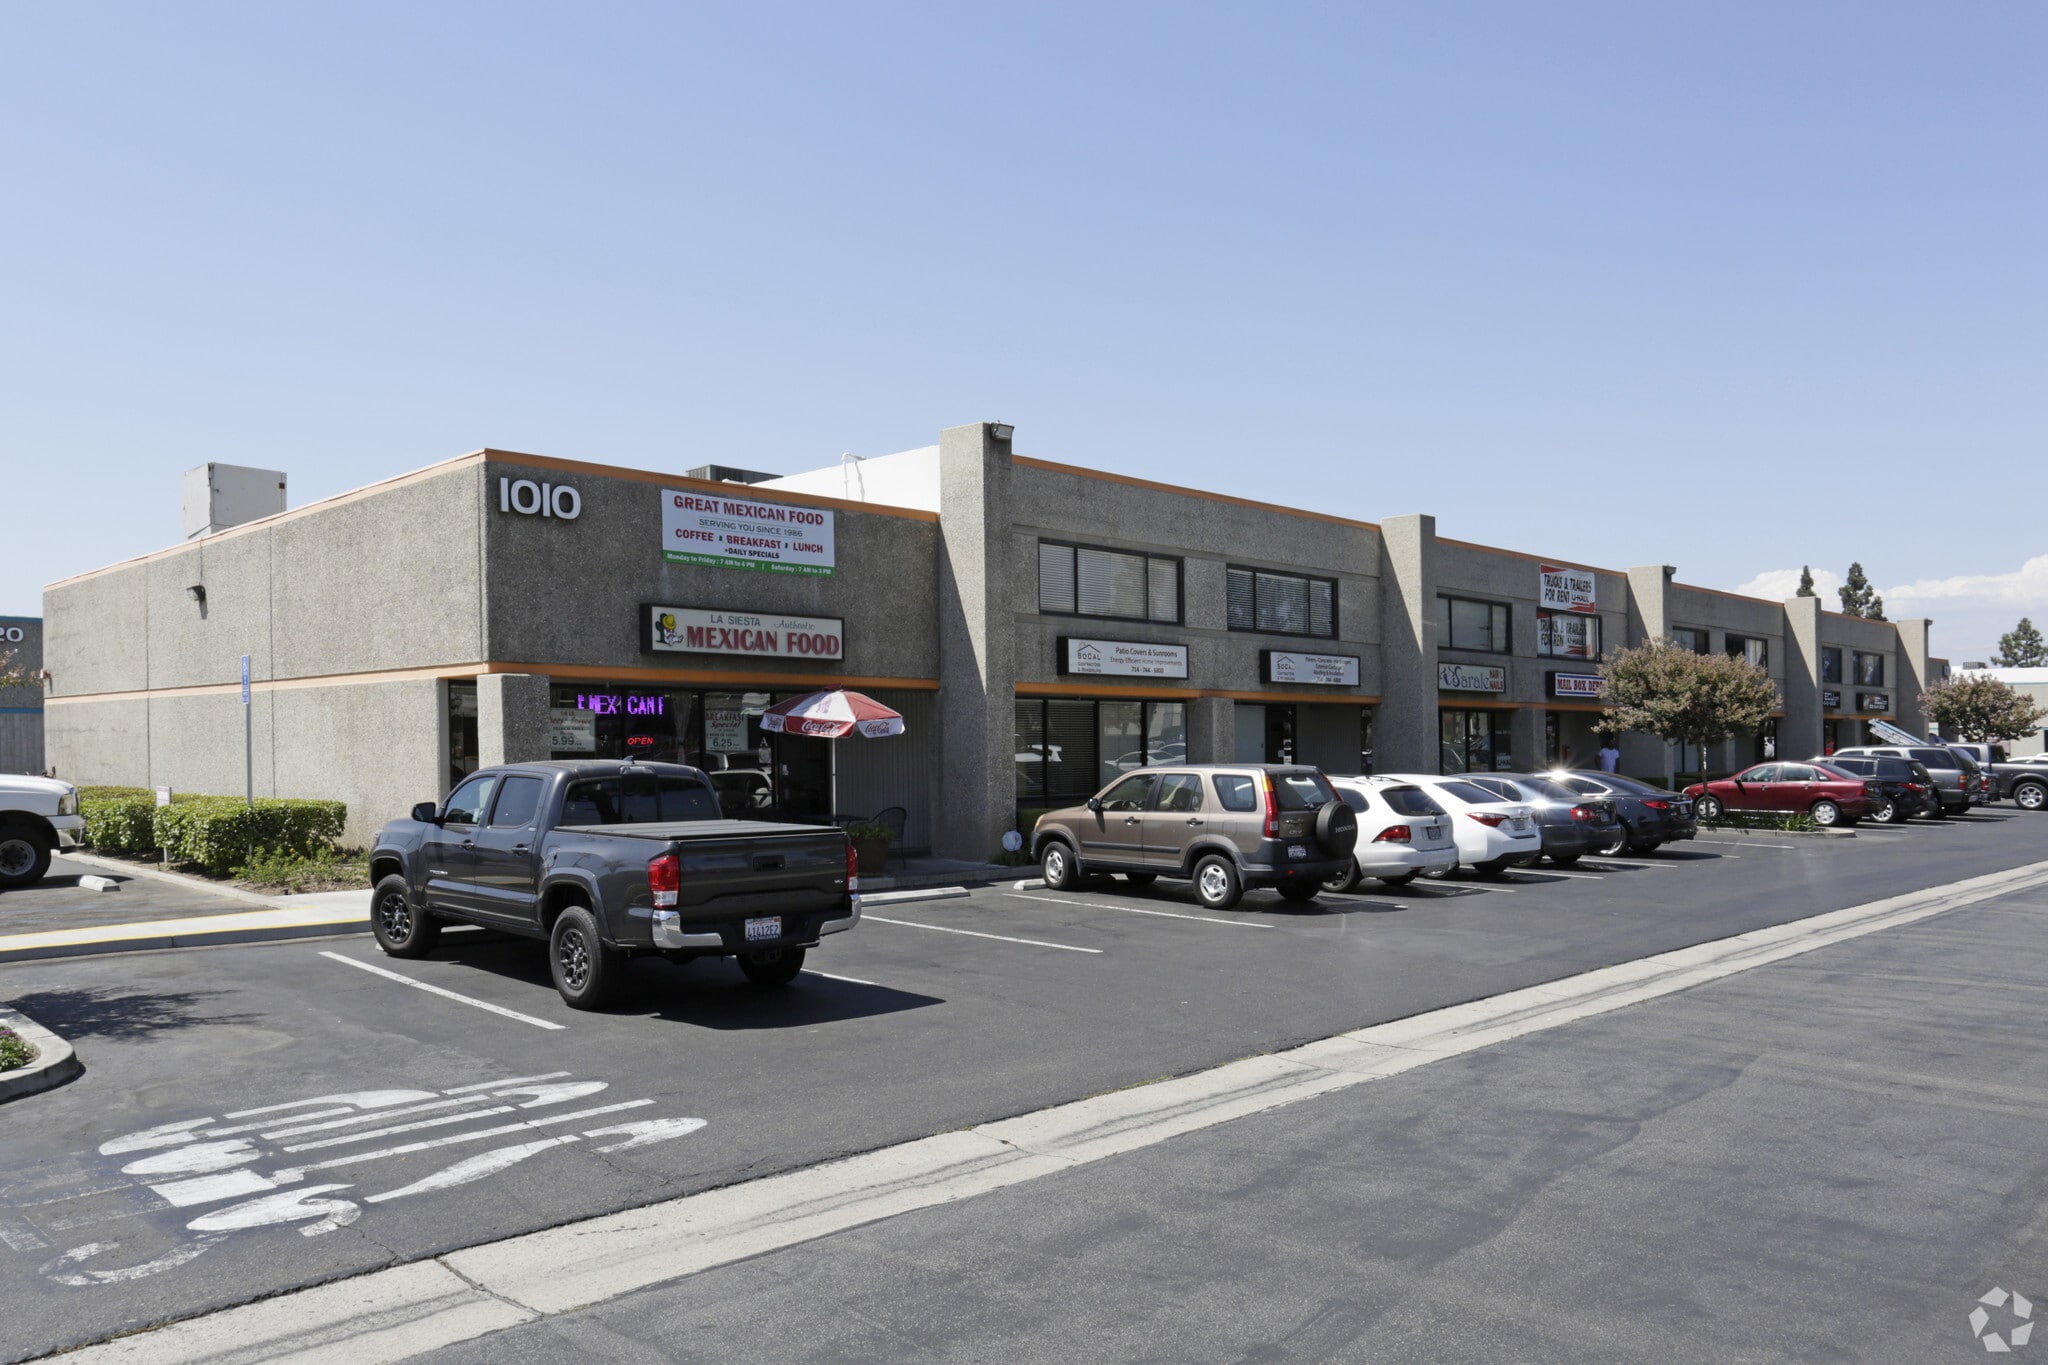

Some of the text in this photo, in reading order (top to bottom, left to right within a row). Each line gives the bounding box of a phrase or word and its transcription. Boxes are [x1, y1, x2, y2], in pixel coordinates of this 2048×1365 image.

[500, 477, 581, 520] 1010
[674, 495, 824, 525] GREAT MEXICAN FOOD
[700, 519, 803, 537] SERVING YOU SINCE 1986
[675, 529, 823, 553] COFFEE BREAKFAST LUNCH
[667, 553, 690, 563] Monday
[749, 550, 780, 559] SPECIALS
[771, 564, 794, 574] Saturday
[823, 567, 831, 575] PM
[1544, 574, 1592, 593] TRUCKS & TRAILERS
[1545, 588, 1555, 602] FOR
[1557, 590, 1570, 603] RENT
[710, 614, 761, 627] LA SIESTA
[687, 626, 840, 655] MEXICAN FOOD
[1541, 633, 1551, 646] FO
[1116, 647, 1129, 655] Patio
[1130, 648, 1148, 656] Covers
[1152, 649, 1178, 658] Sunrooms
[1489, 680, 1504, 690] NAILS
[1557, 678, 1605, 692] MAIL BOX DEP
[552, 736, 575, 746] 5.99
[627, 736, 653, 746] OPEN
[713, 738, 732, 747] 6.25
[760, 736, 769, 747] A
